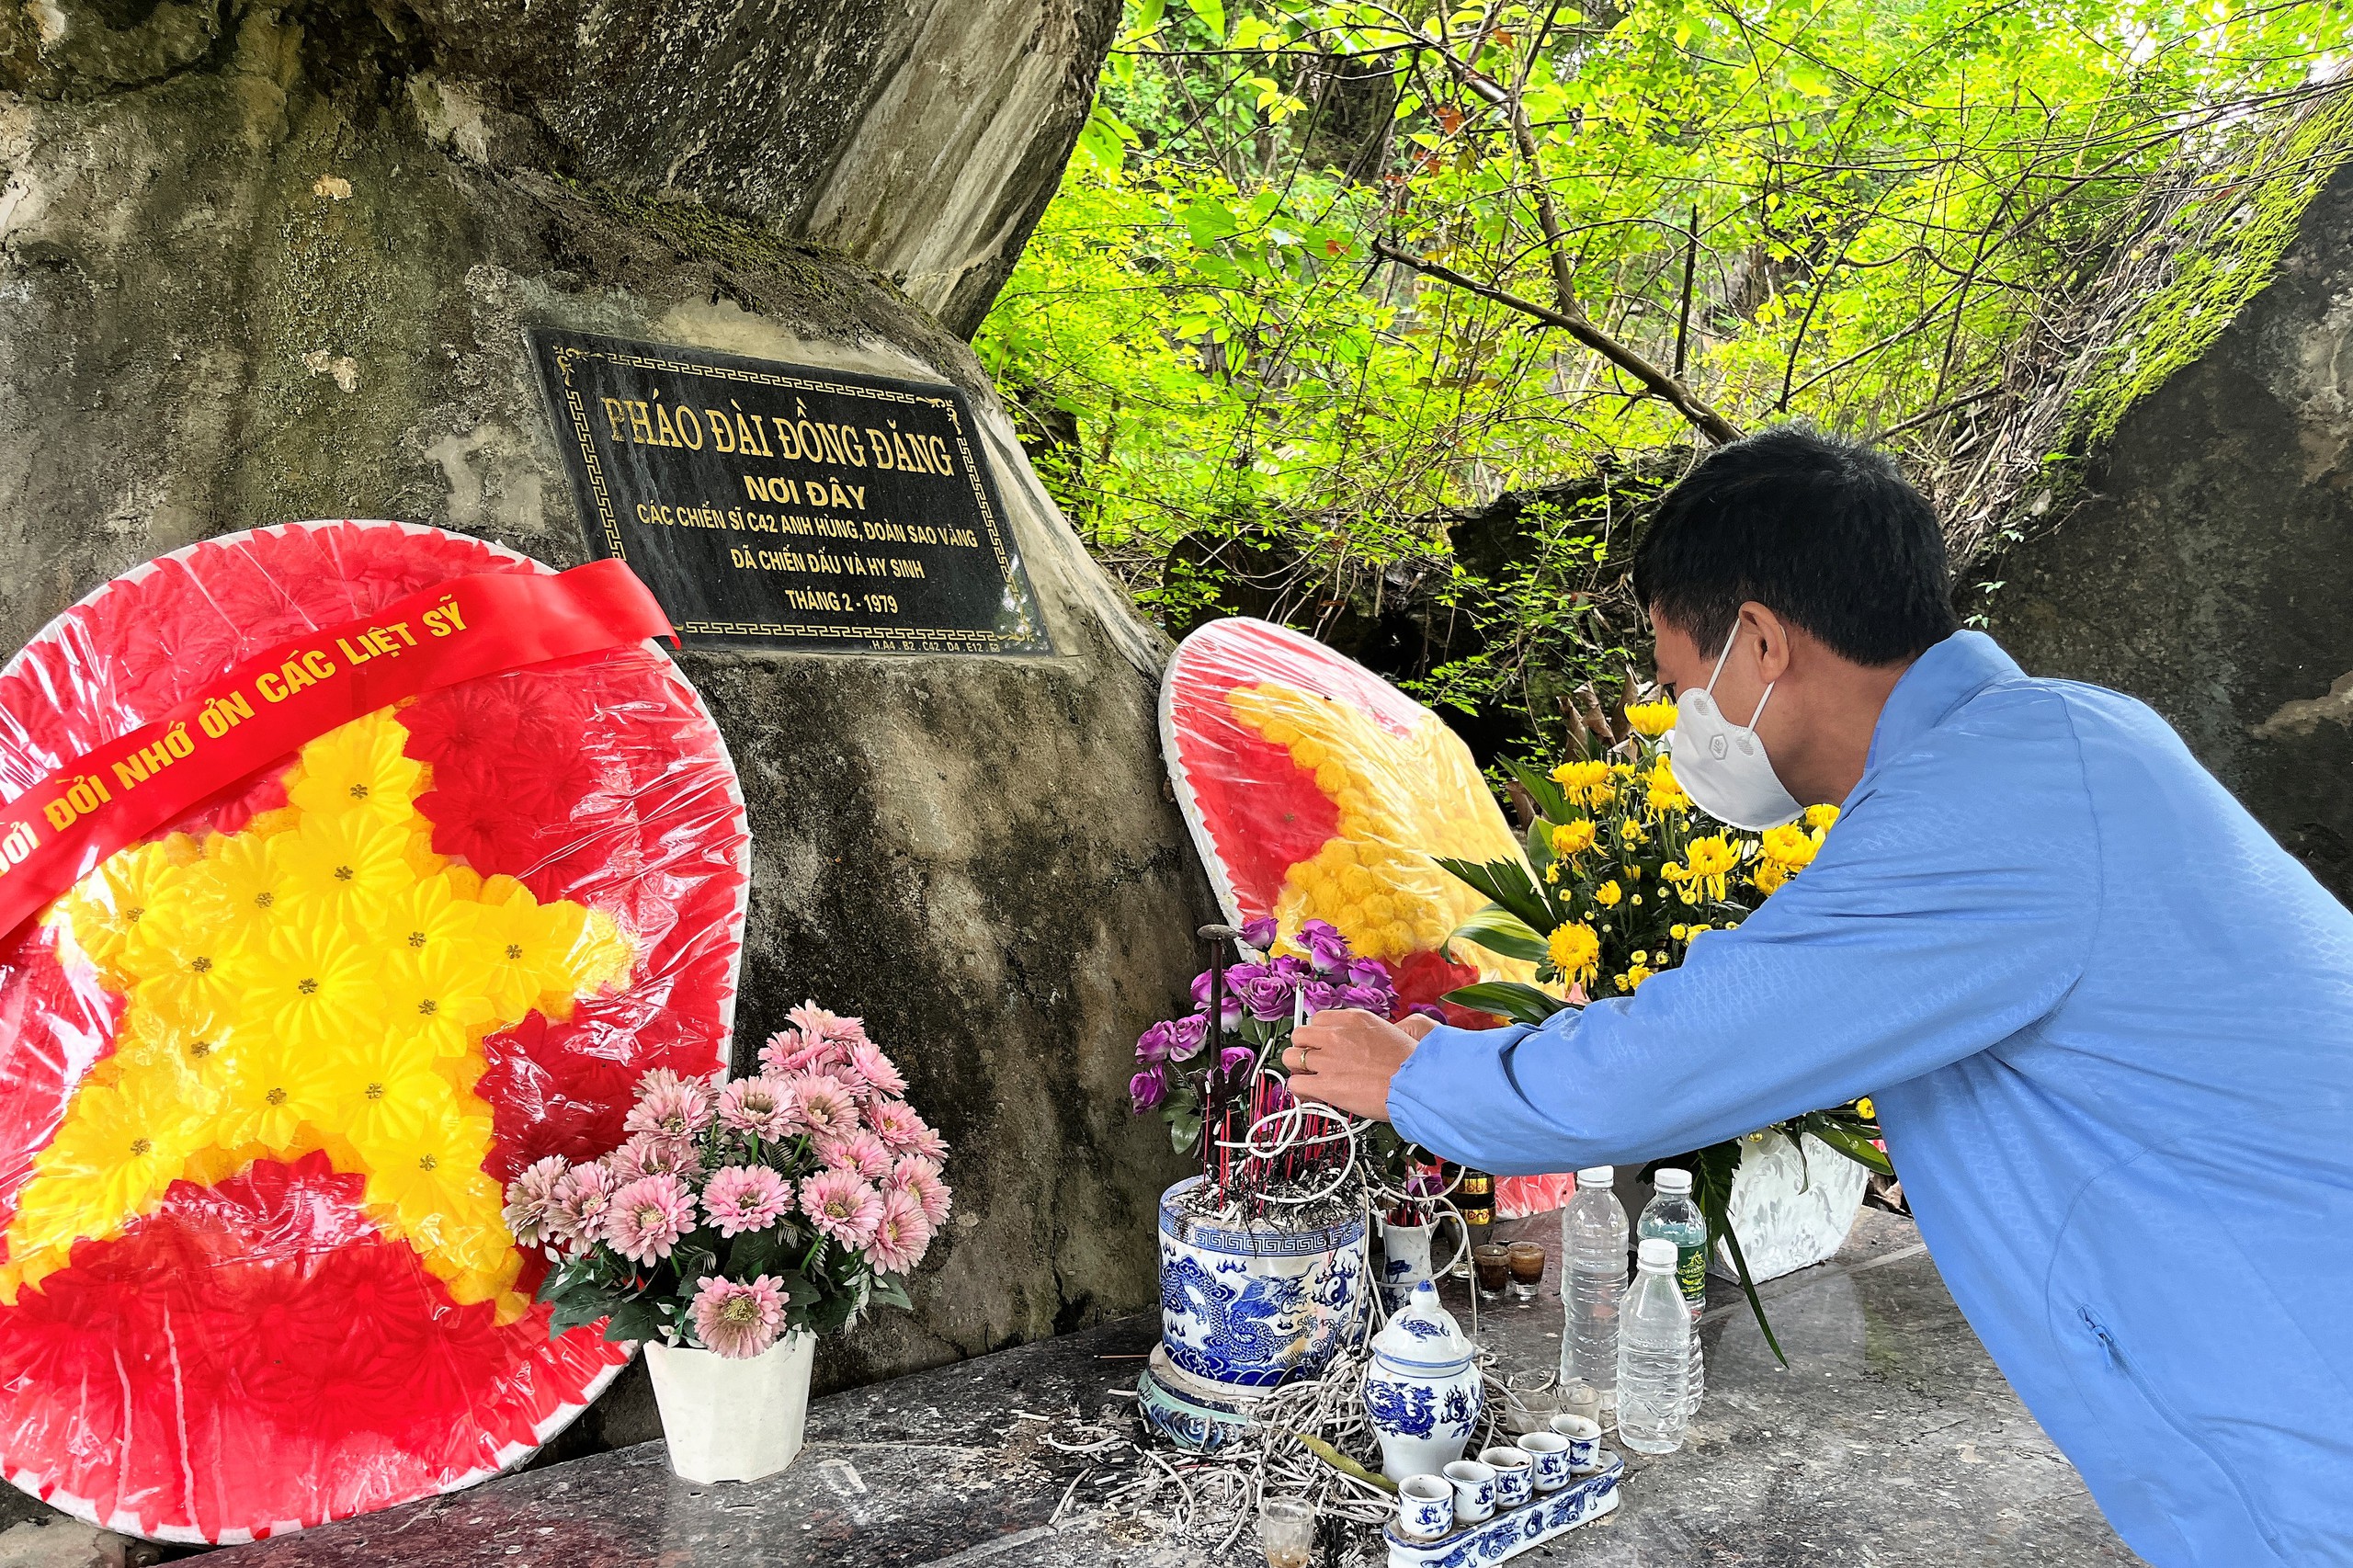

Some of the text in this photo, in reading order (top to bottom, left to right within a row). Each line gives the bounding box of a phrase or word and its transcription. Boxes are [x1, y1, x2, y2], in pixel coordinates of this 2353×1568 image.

[600, 388, 954, 476] PHÁO ĐÀI ĐỒNG ĐĂNG
[743, 475, 866, 510] NƠI ĐÂY
[636, 499, 979, 548] CÁC CHIẾN SĨ C42 ANH HÙNG, ĐOÀN SAO VÀNG
[730, 543, 926, 579] ĐÃ CHIẾN ĐẤU VÀ HY SINH
[785, 585, 841, 611] THÁNG
[842, 593, 855, 612] 2
[863, 594, 899, 614] 1979
[43, 775, 112, 833] ĐỜI
[111, 721, 196, 790] NHỚ
[198, 698, 256, 739] ƠN
[256, 649, 336, 703] CÁC
[335, 622, 418, 665] LIỆT
[422, 594, 467, 638] SỸ
